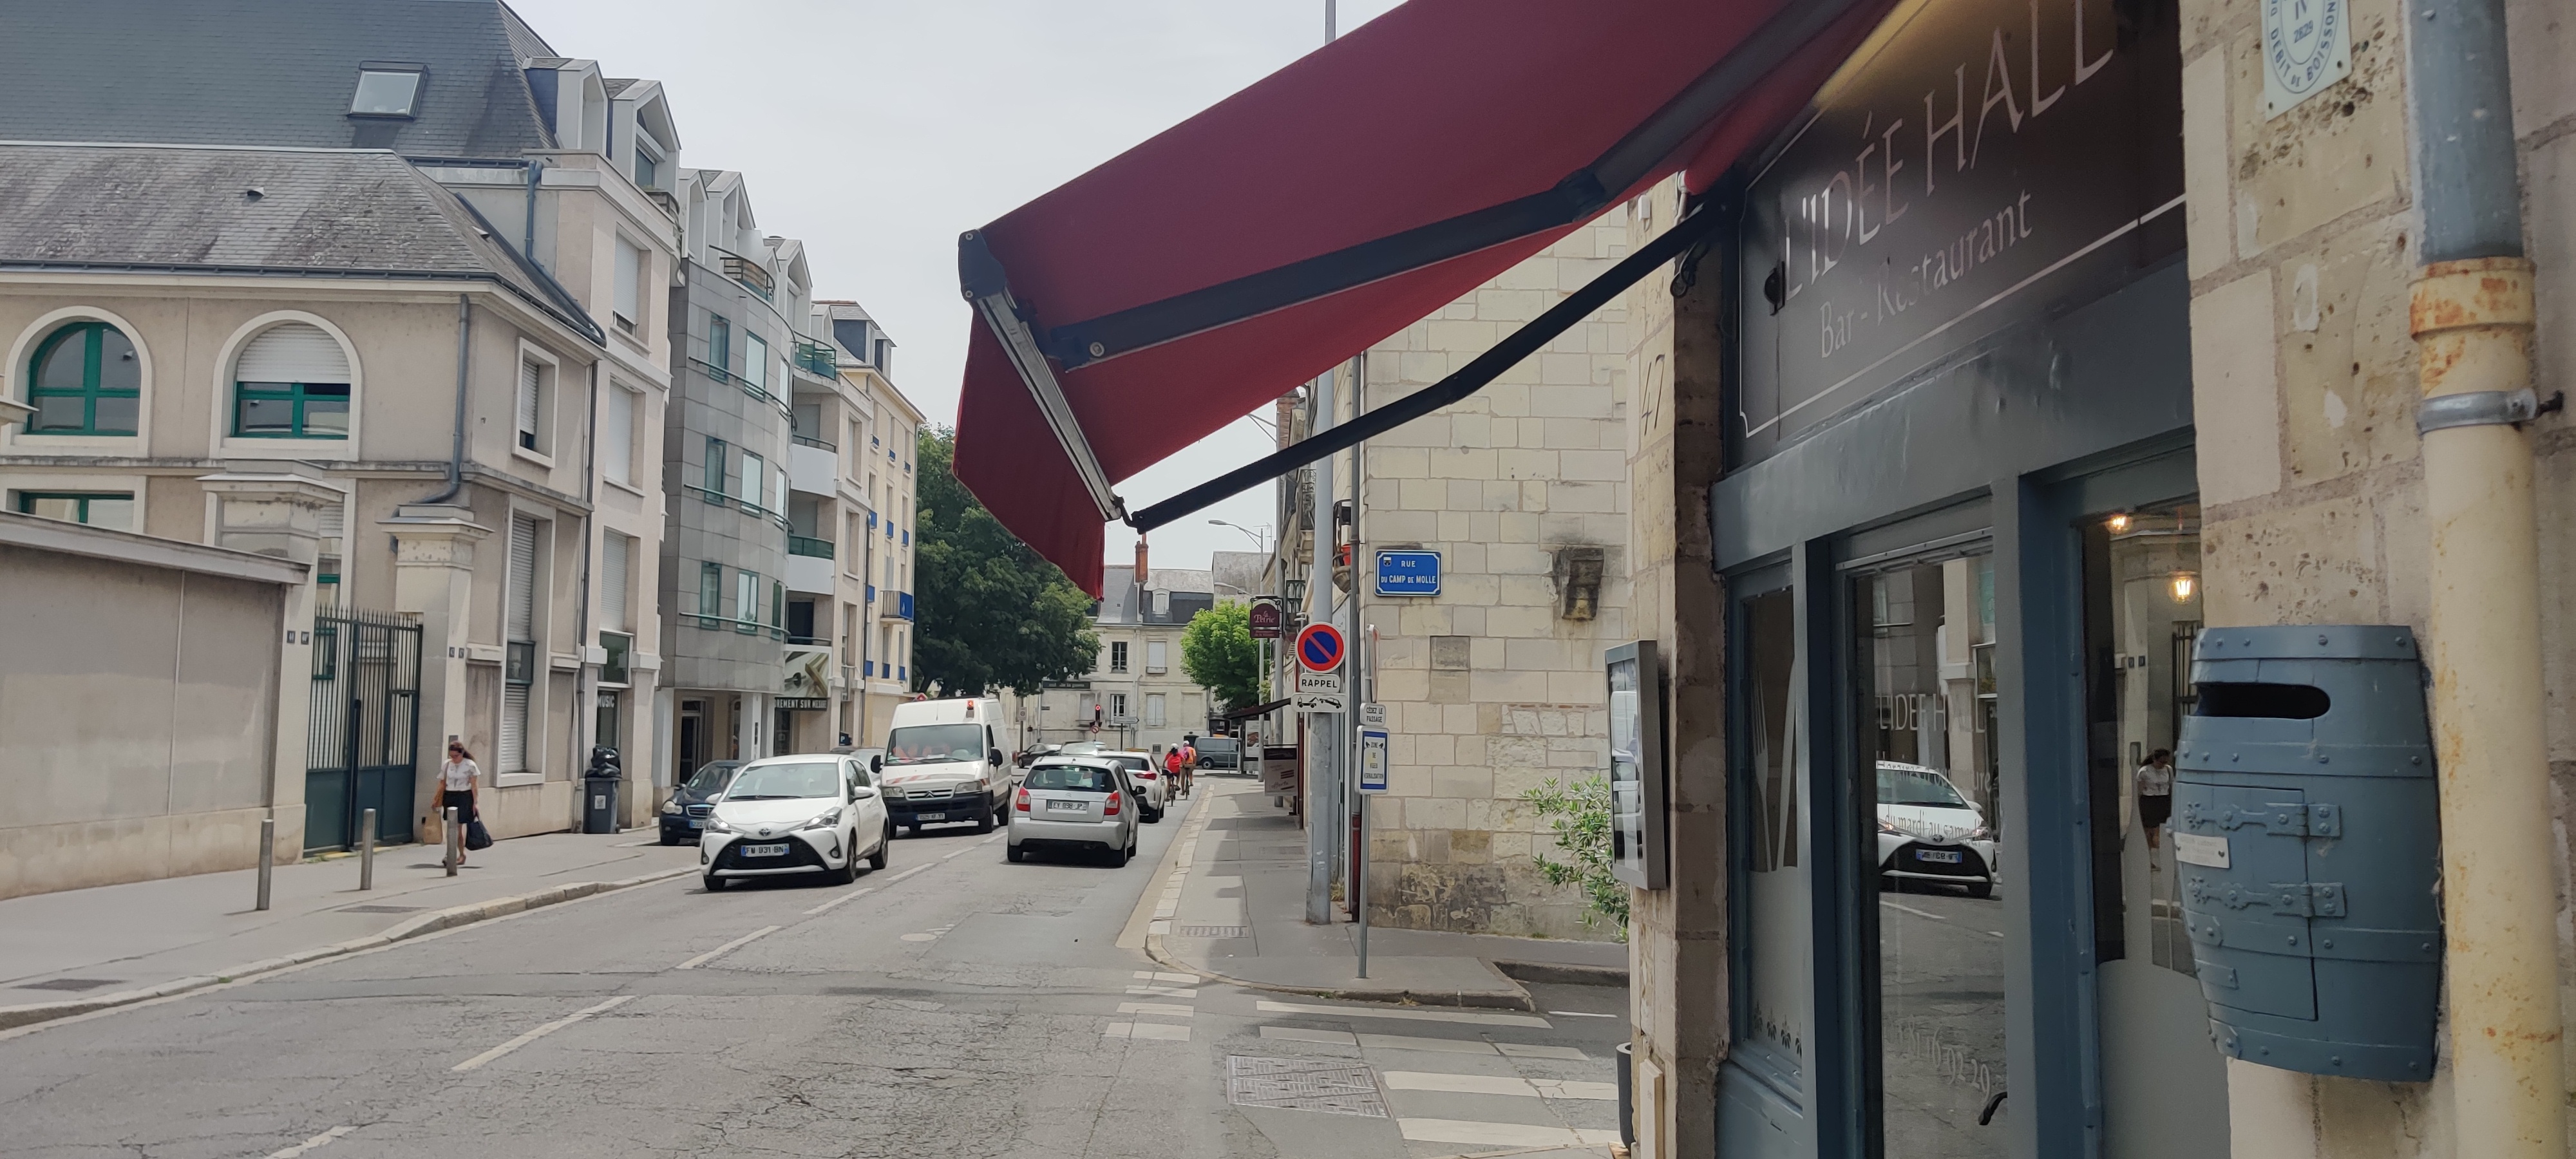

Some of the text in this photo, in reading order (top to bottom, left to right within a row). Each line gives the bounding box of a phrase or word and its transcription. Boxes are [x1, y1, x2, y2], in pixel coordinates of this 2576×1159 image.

[2306, 0, 2337, 82] BOISSON
[1783, 0, 2115, 302] L'IDÉE HALL
[1819, 301, 1856, 359] Bar
[1876, 187, 2033, 328] Restaurant
[1641, 353, 1666, 437] 47
[1388, 574, 1406, 583] CAMP
[1416, 575, 1436, 584] MOLLE
[800, 699, 811, 708] SUR
[1302, 679, 1338, 688] RAPPEL
[1898, 809, 1925, 838] mardi
